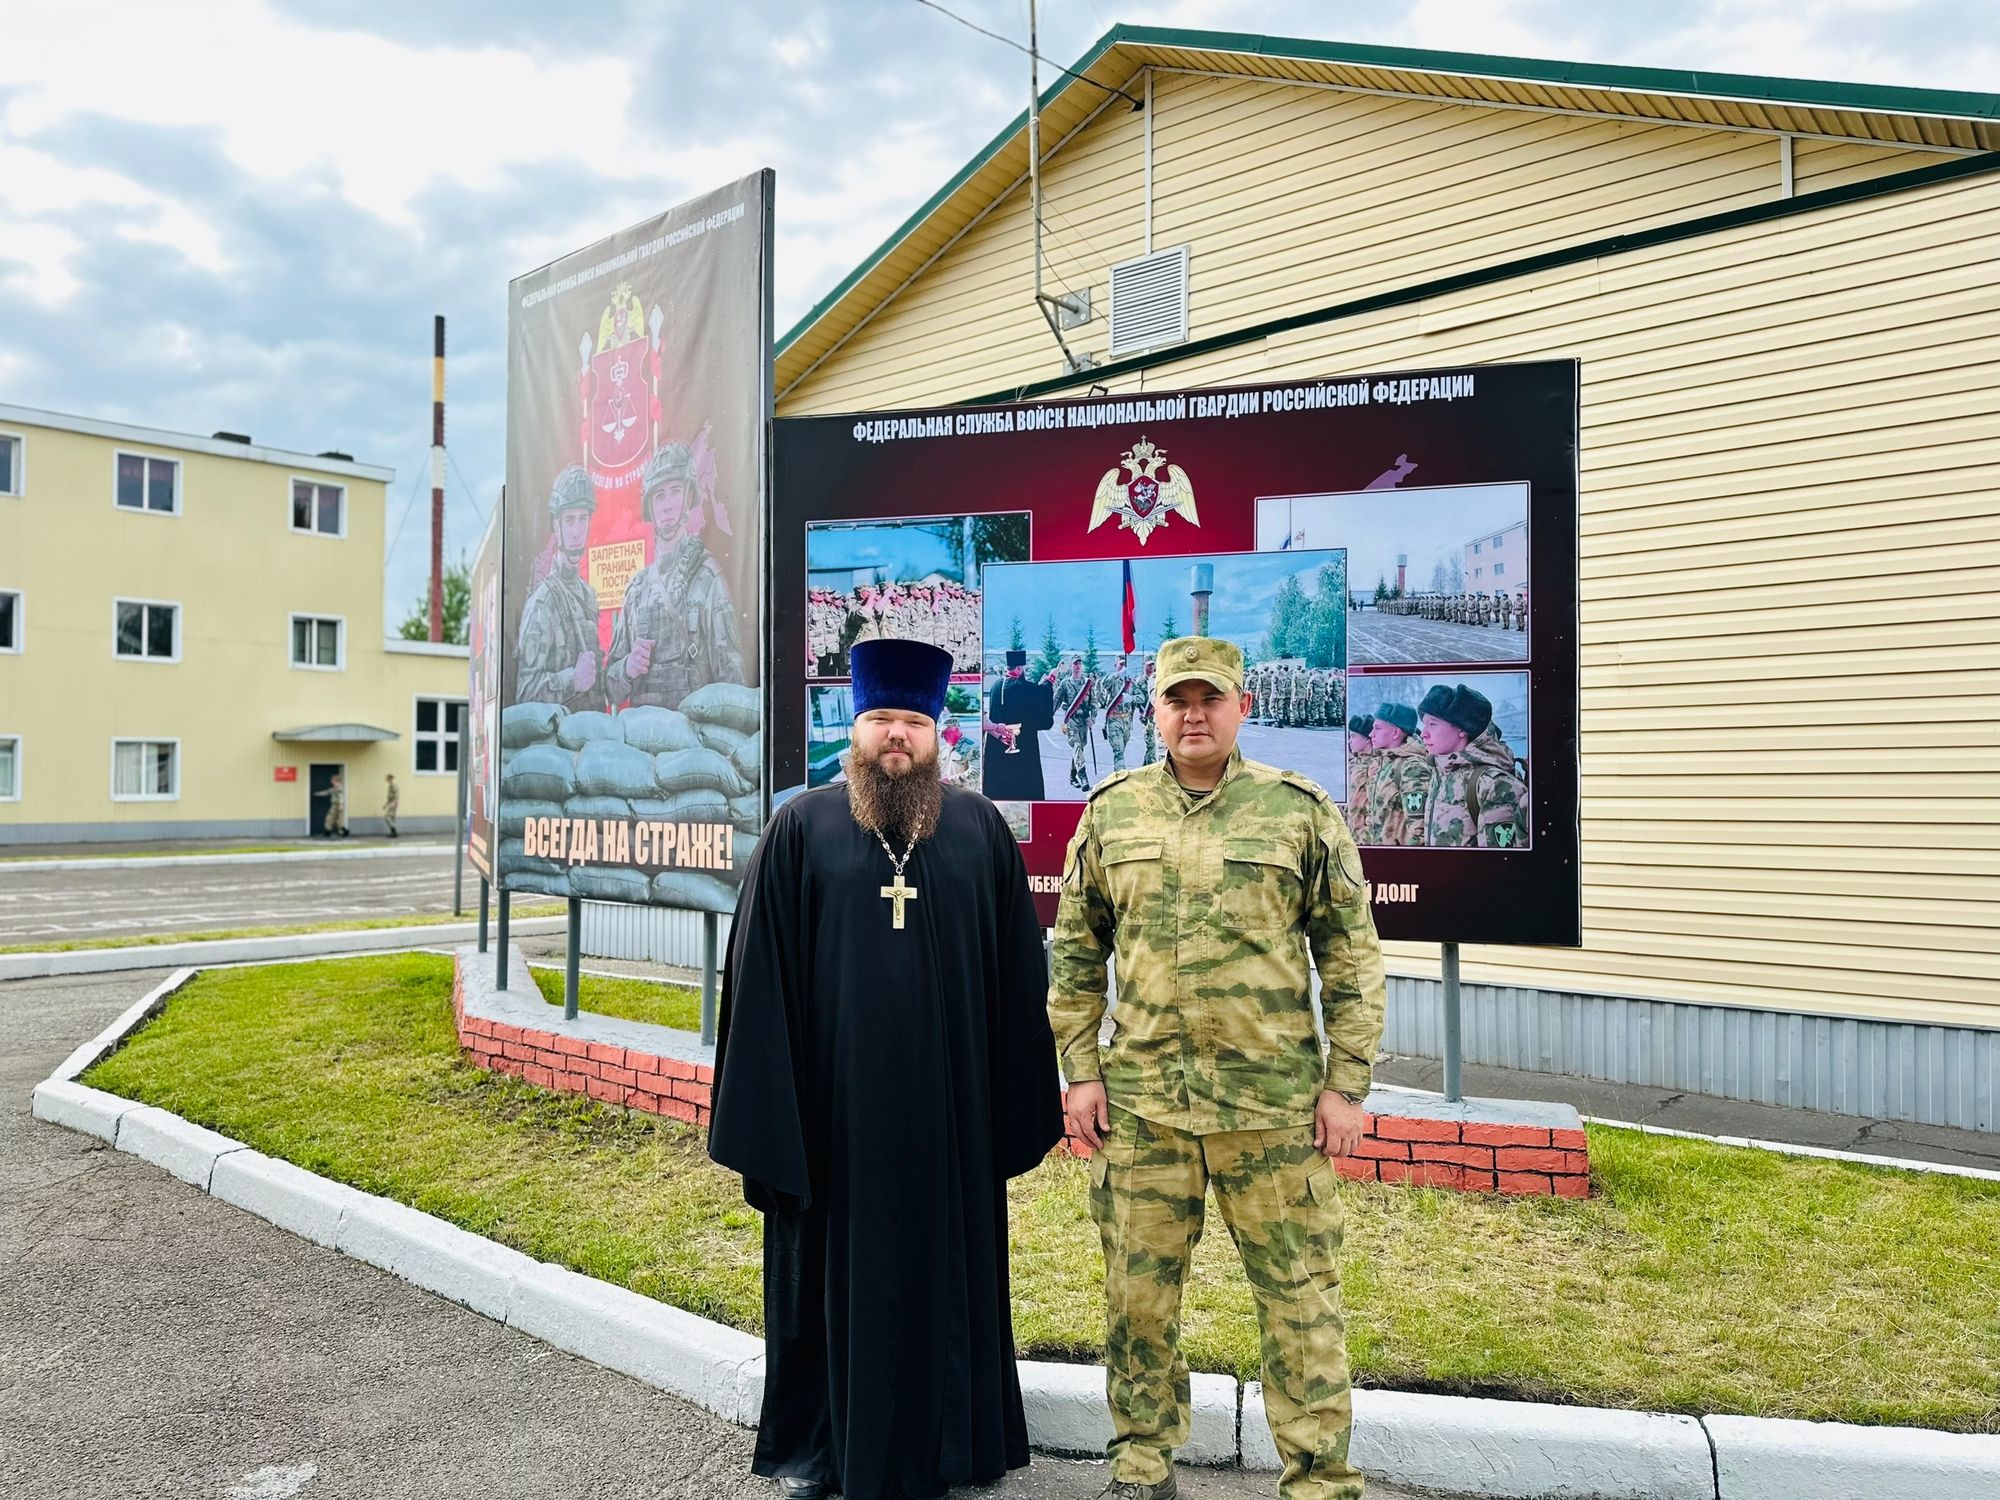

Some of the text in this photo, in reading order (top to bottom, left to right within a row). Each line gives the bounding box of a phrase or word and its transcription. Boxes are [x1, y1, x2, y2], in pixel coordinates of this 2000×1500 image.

[705, 202, 745, 231] ФЕДЕРАЦИИ
[853, 375, 1475, 443] ФЕДЕРАЛЬНАЯ СЛУЖБА ВОЙСК НАЦИОНАЛЬНОЙ ГВАРДИИ РОССИЙСКОЙ ФЕДЕРАЦИИ
[591, 542, 643, 562] ЗАПРЕТНАЯ
[596, 559, 637, 577] ГРАНИЦА
[602, 574, 630, 589] ПОСТА
[524, 816, 598, 867] ВСЕГДА
[602, 820, 630, 863] НА
[634, 820, 734, 871] СТРАЖЕ!
[1027, 875, 1063, 893] УБЕЖ
[1375, 883, 1419, 905] ДОЛГ
